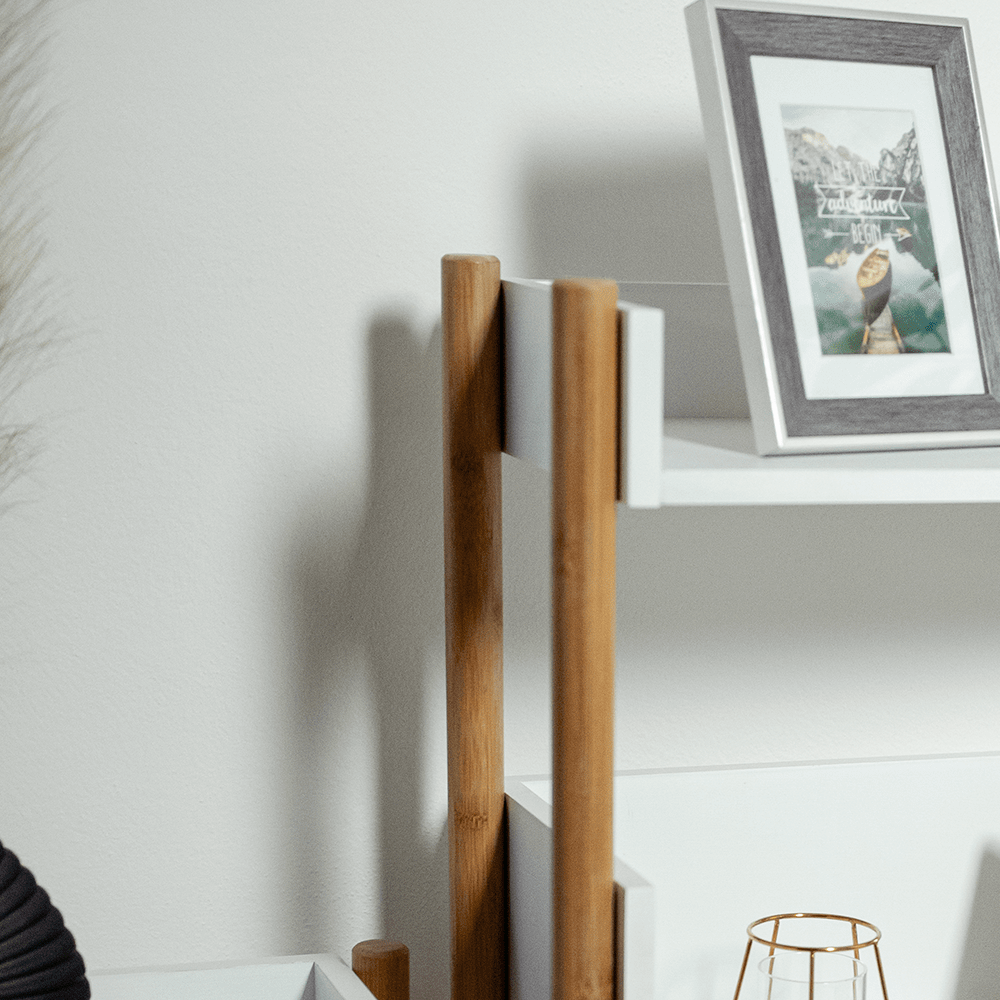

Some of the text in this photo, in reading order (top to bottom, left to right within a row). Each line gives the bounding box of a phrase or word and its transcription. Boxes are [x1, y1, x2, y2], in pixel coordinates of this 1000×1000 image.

[858, 161, 882, 183] THE
[828, 191, 898, 214] adventure
[851, 223, 882, 245] BEGIN
